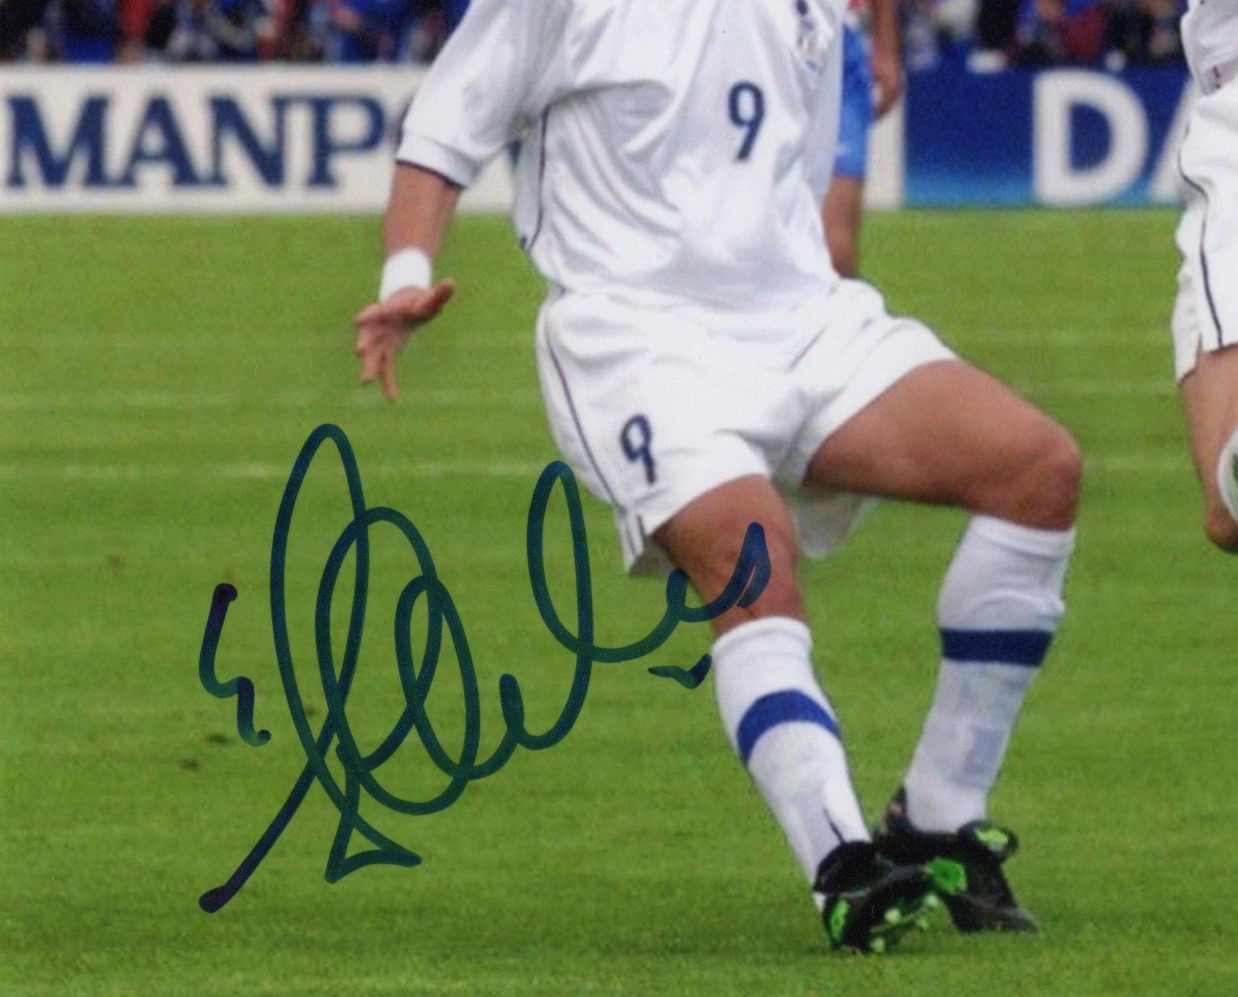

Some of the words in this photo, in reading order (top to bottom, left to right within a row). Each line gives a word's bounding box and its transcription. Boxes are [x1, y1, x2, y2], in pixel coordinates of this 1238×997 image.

[6, 92, 398, 190] MANP
[728, 81, 765, 161] 9
[620, 413, 657, 486] 9
